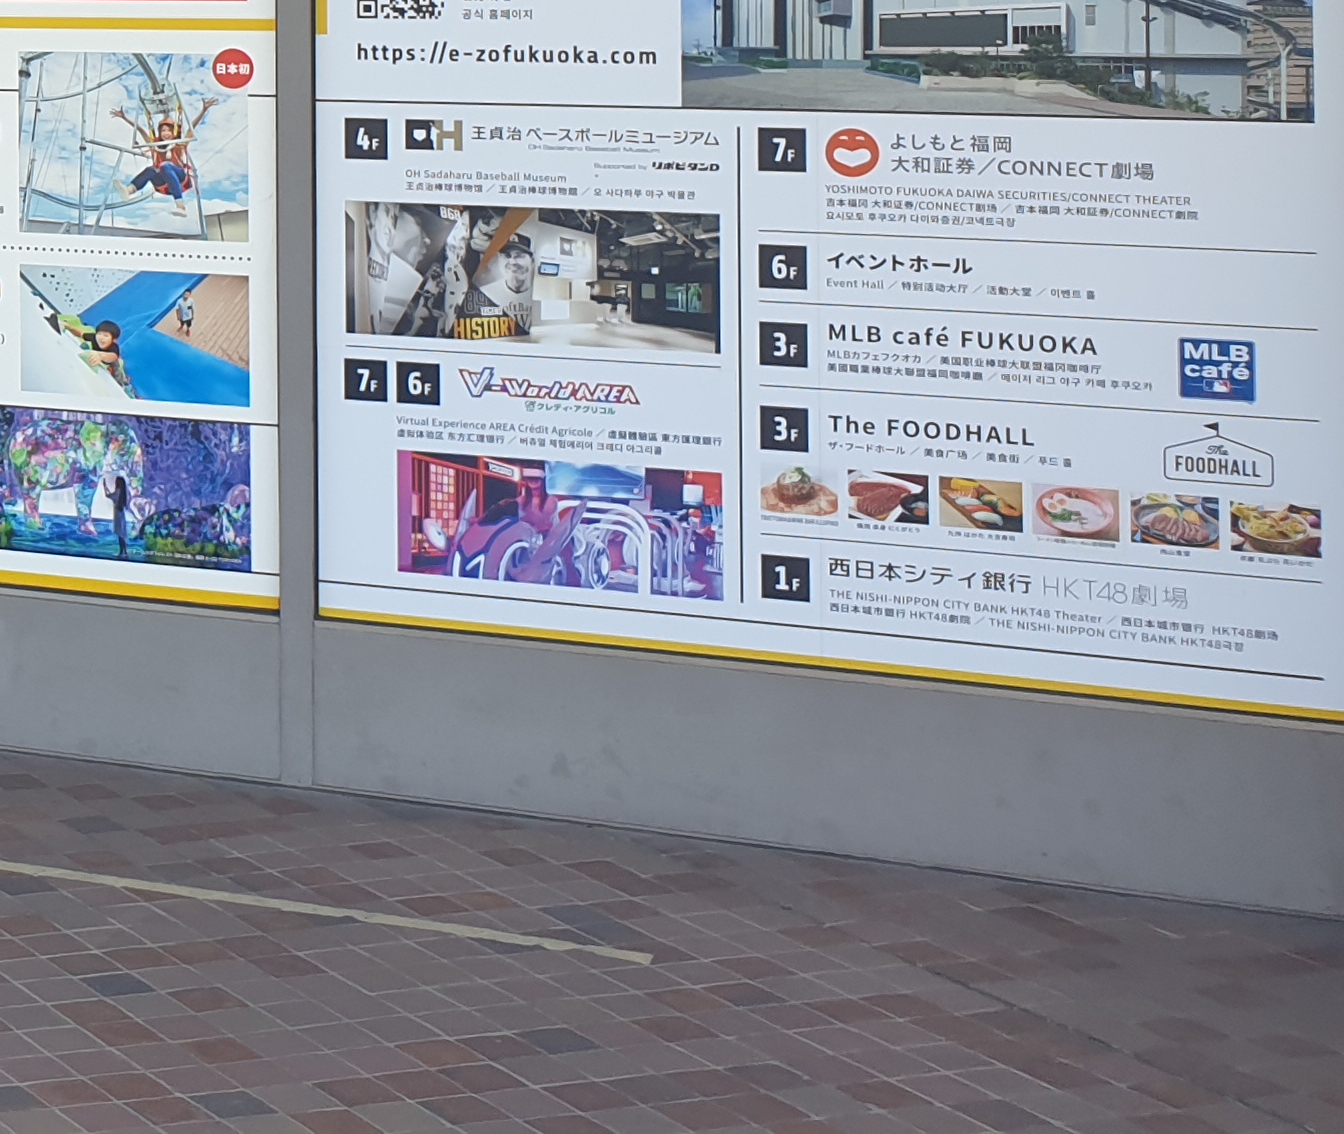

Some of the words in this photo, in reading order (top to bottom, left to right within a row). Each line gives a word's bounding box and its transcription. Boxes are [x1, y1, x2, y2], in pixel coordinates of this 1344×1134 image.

[358, 41, 656, 64] https://e-zofukuoka.com
[217, 63, 250, 74] 日本初
[472, 126, 521, 141] 王貞治
[406, 169, 421, 179] OH
[424, 170, 472, 179] Sadaharu
[476, 171, 519, 181] Baseball
[524, 173, 566, 182] Museum
[825, 185, 893, 195] YOSHIMOTO
[897, 187, 953, 197] FUKUOKA
[957, 189, 994, 198] DAIWA
[998, 190, 1130, 203] SECURITIES/CONNECT
[1135, 195, 1190, 205] THEATER
[827, 253, 972, 274] イベントホール
[827, 278, 857, 288] Event
[862, 280, 883, 289] Hall
[829, 324, 881, 342] MLB
[893, 326, 948, 347] café
[962, 331, 1097, 355] FUKUOKA
[1183, 341, 1249, 364] MLB
[1184, 360, 1250, 381] café
[396, 416, 429, 426] Virtual
[432, 418, 486, 430] Experience
[489, 423, 515, 431] AREA
[552, 426, 593, 437] Agricole
[828, 415, 875, 435] The
[888, 419, 1034, 446] FOODHALL
[1176, 455, 1261, 477] FOODHALL
[829, 558, 1031, 597] 西日本シティ銀行
[1042, 576, 1188, 609] HKT48劇場
[830, 589, 852, 599] THE
[856, 592, 939, 608] NISHI-NIPPON
[943, 599, 969, 610] CITY
[974, 603, 1007, 614] BANK
[1011, 607, 1050, 618] HKT48
[1054, 611, 1101, 623] Theater
